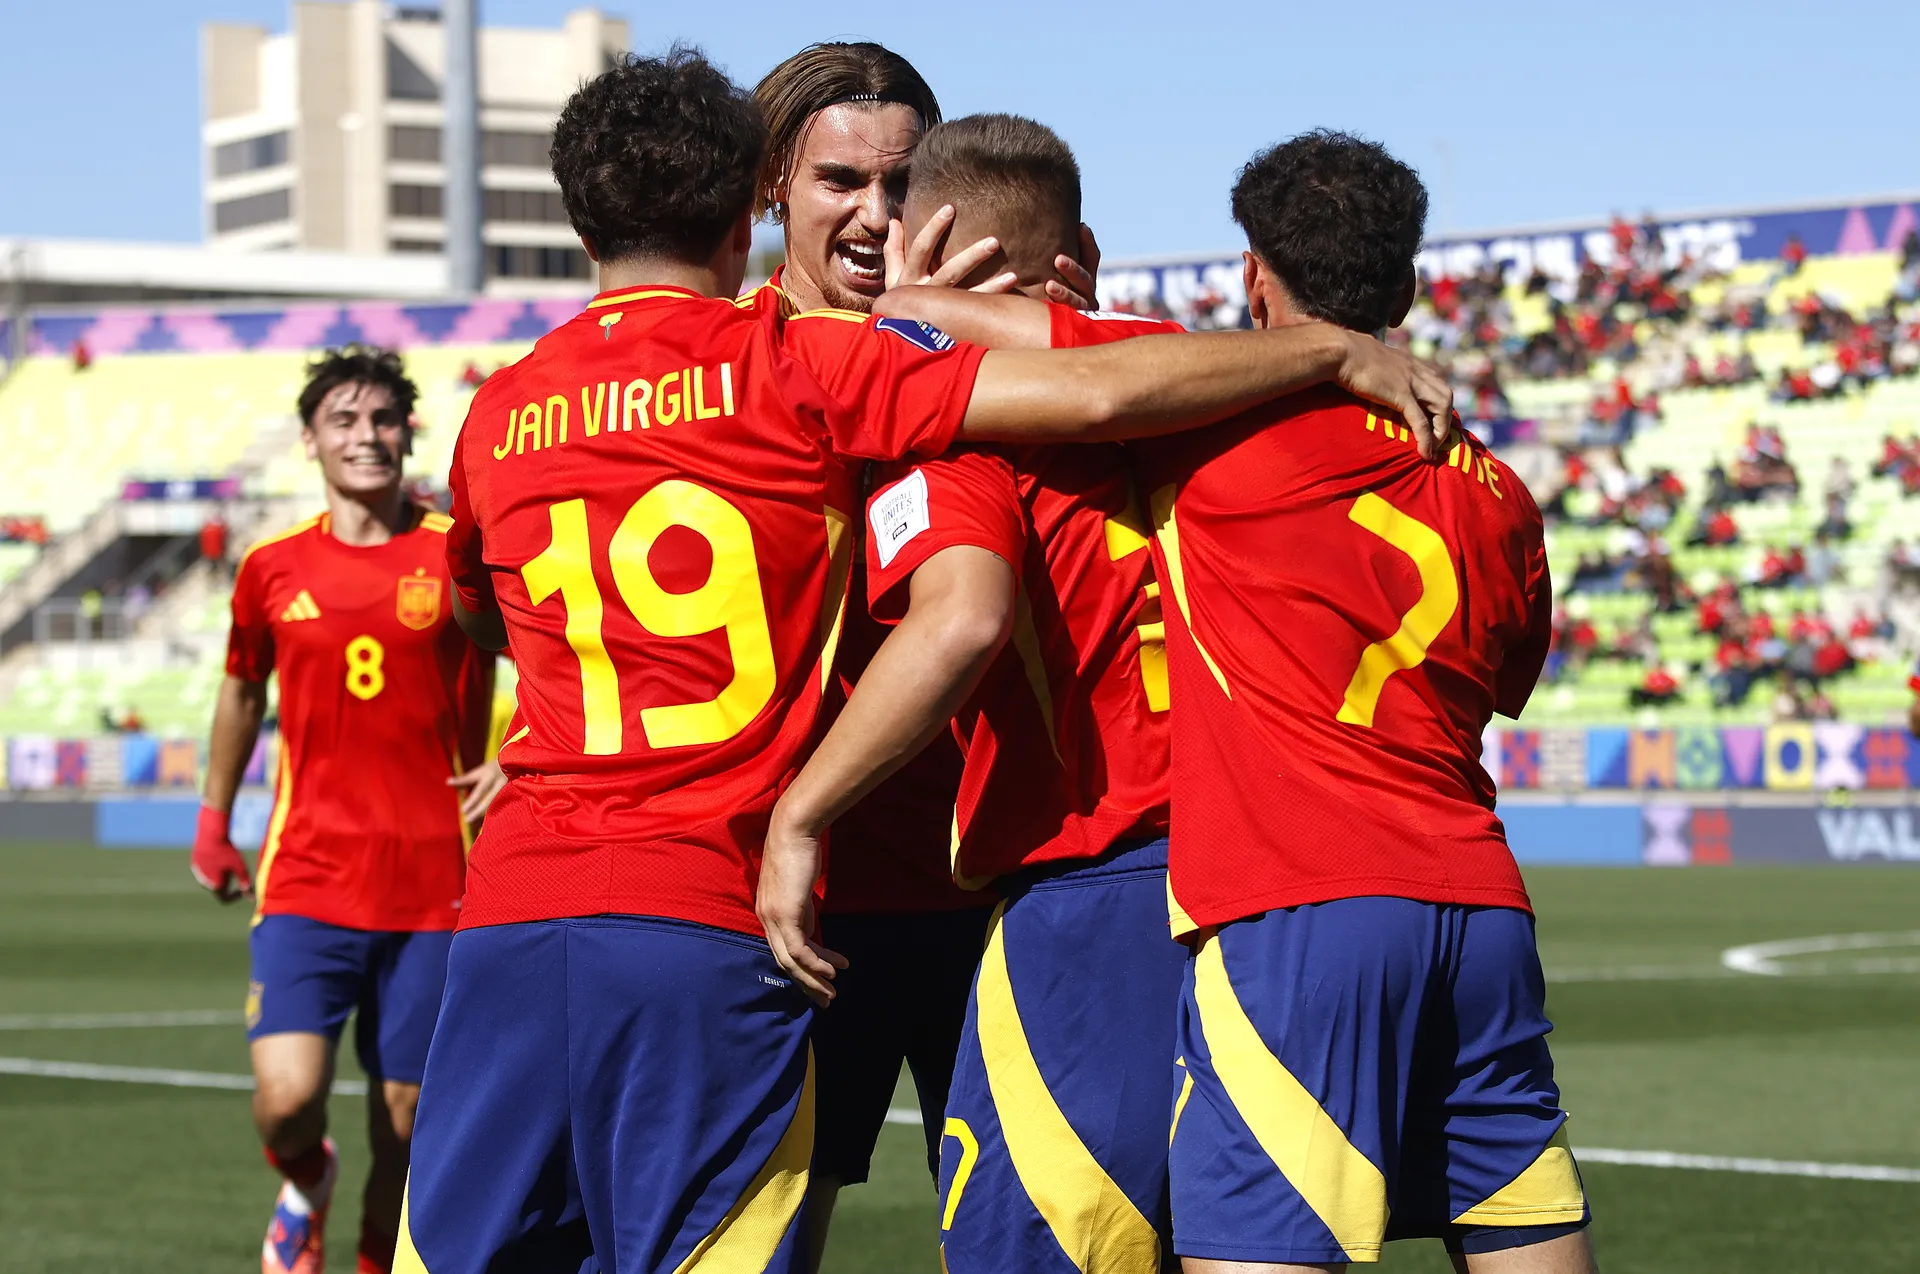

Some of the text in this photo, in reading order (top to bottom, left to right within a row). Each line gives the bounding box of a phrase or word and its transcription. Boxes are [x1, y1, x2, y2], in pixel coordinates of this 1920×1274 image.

[493, 363, 734, 460] JAN VIRGILI
[520, 479, 777, 756] 19
[345, 635, 385, 700] 8
